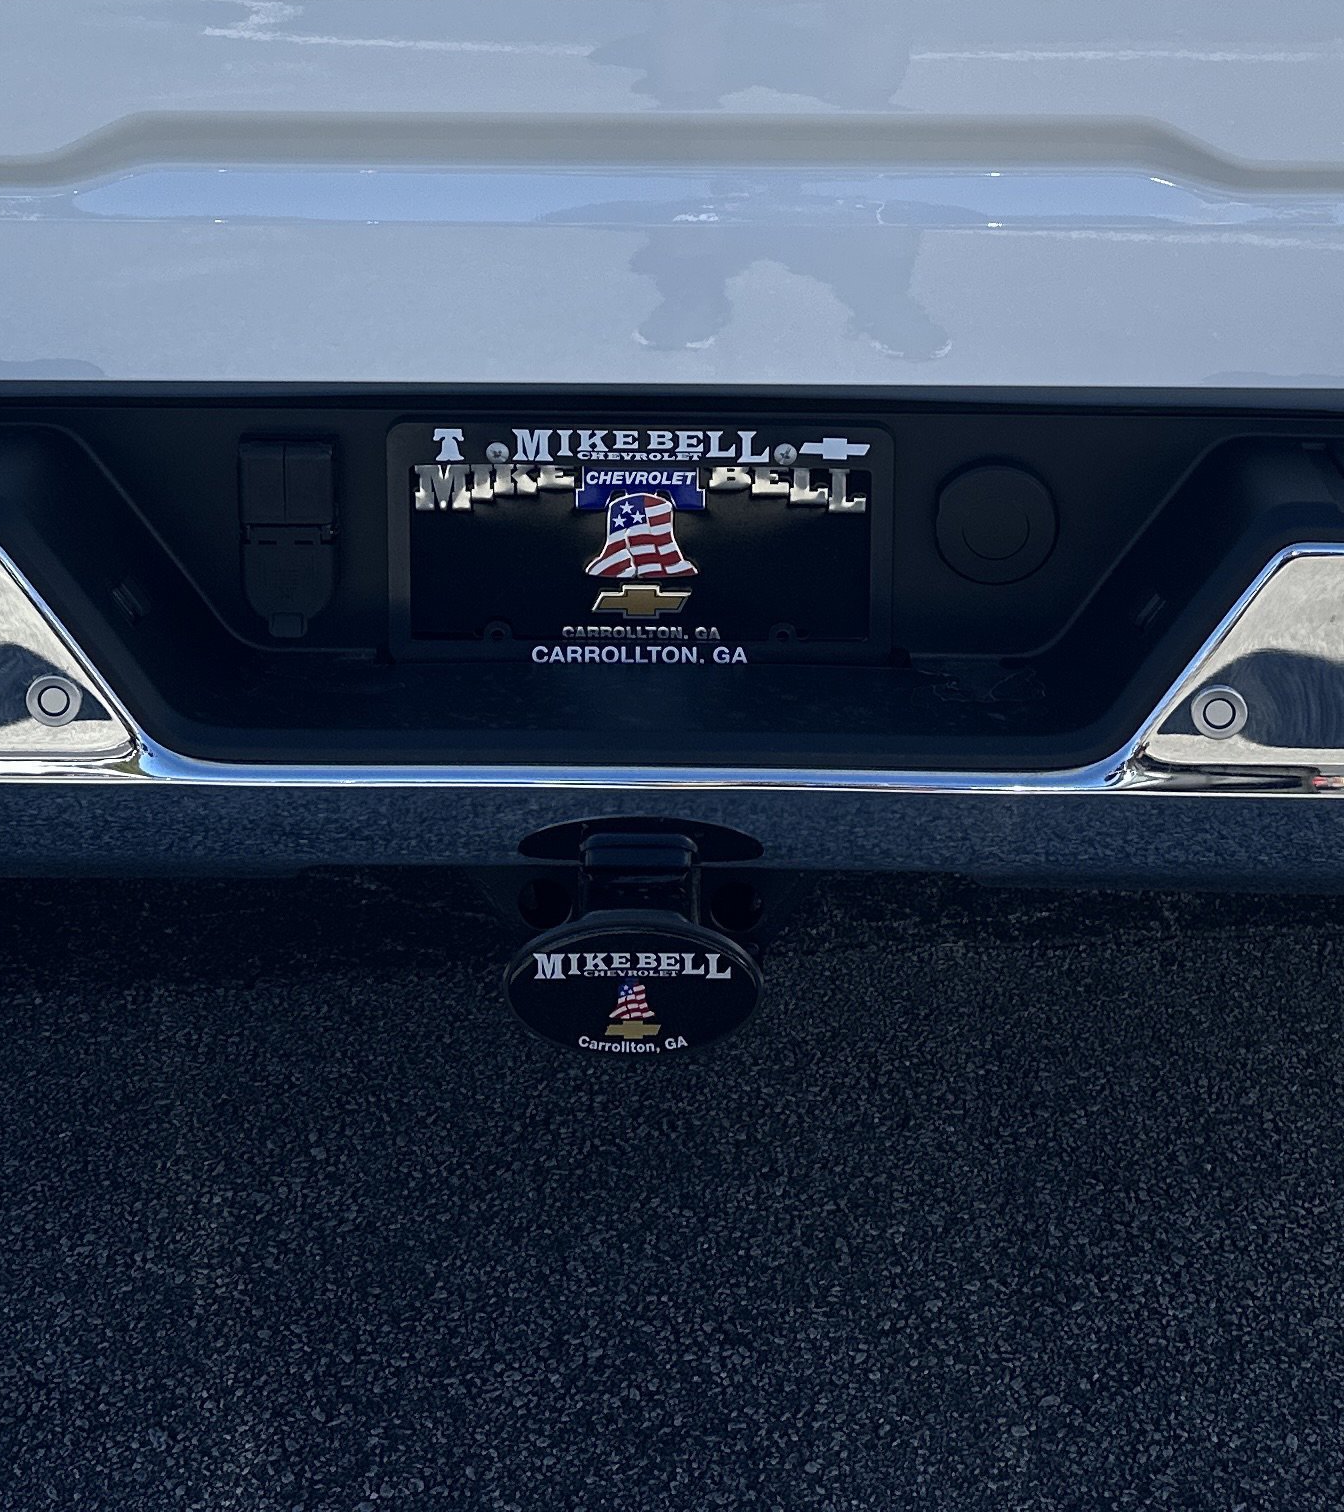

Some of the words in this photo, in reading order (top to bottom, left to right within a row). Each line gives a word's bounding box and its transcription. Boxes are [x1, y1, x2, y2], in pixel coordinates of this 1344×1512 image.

[512, 428, 639, 462] MIKE
[647, 430, 770, 463] BELL
[577, 451, 702, 461] CHEVROLET
[585, 470, 696, 486] CHEVROLET
[414, 464, 575, 511] MIKE
[709, 466, 867, 513] BELL
[694, 626, 722, 639] GA
[712, 646, 748, 664] GA
[533, 953, 631, 980] MIKE
[635, 953, 732, 979] BELL
[583, 969, 679, 978] CHEVROLET
[578, 1035, 661, 1054] Carrollton,
[664, 1035, 689, 1050] GA
